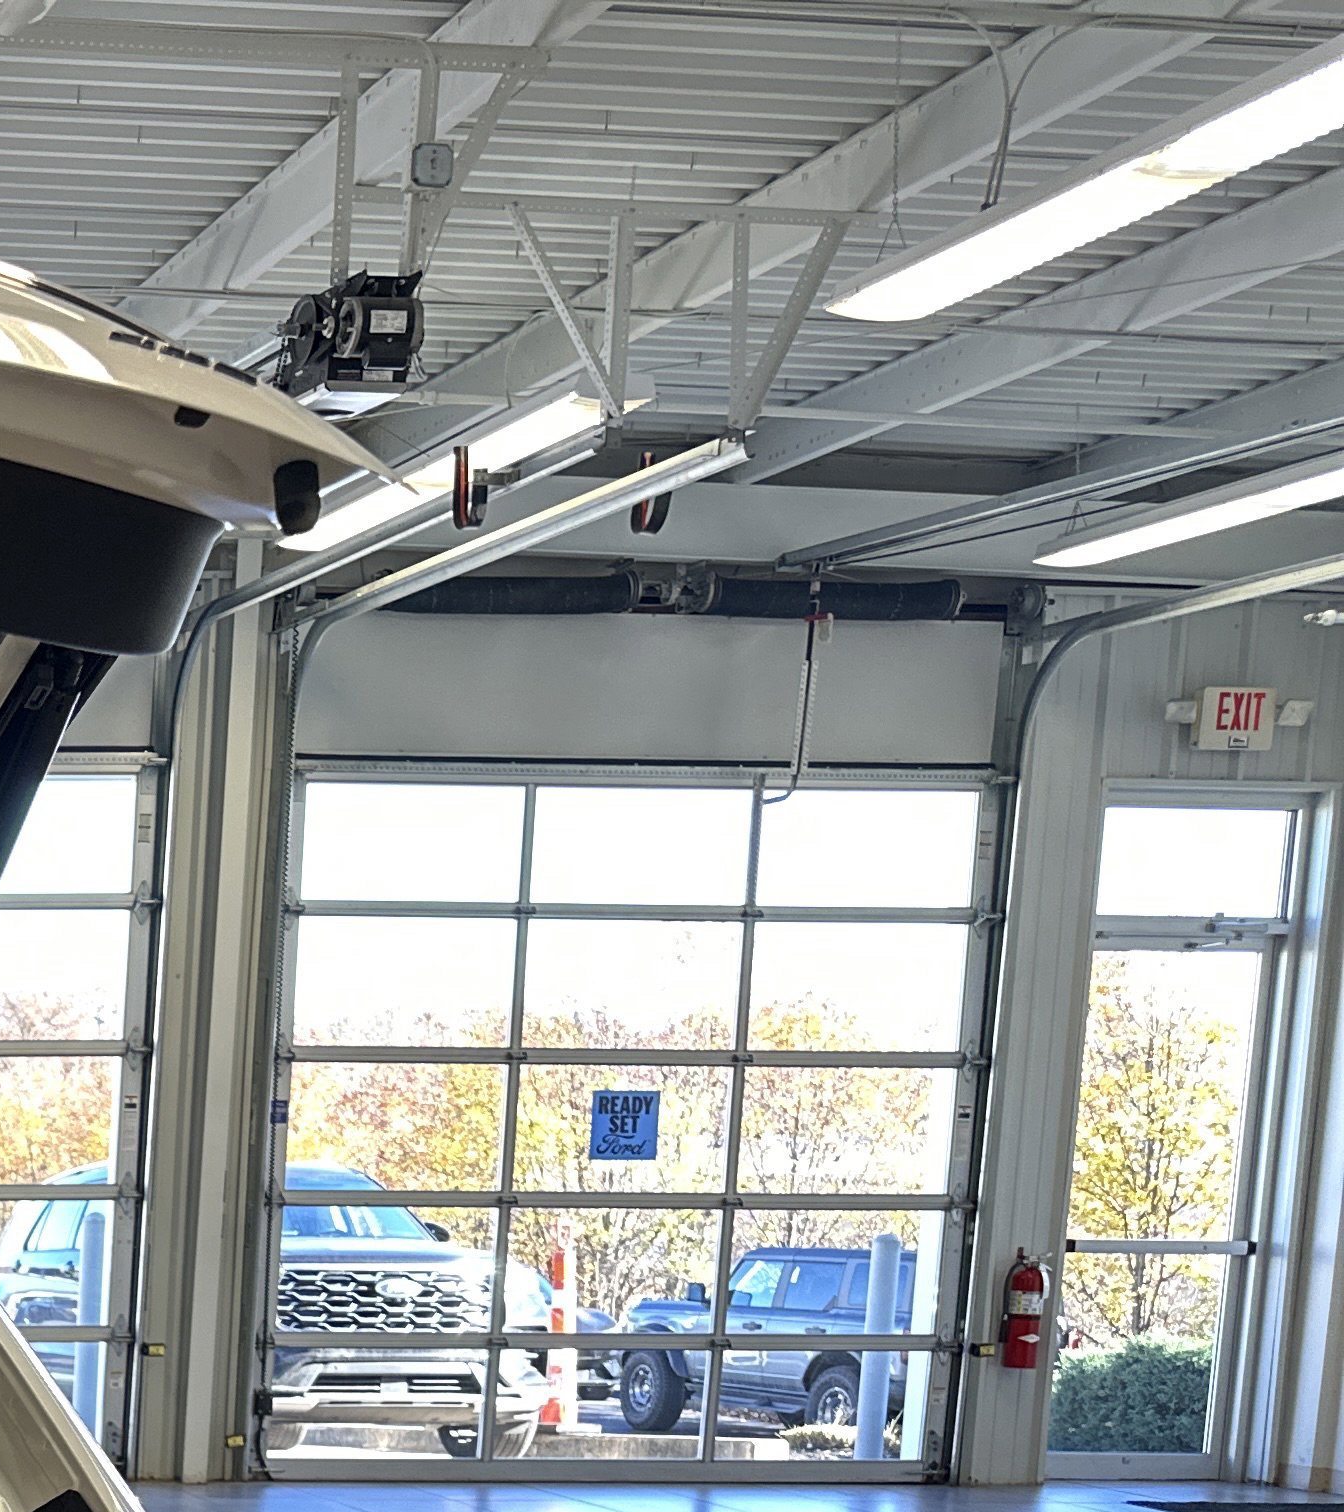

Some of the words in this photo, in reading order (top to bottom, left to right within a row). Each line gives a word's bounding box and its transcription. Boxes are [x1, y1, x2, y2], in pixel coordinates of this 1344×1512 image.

[1216, 692, 1266, 731] EXIT
[598, 1096, 653, 1115] READY
[608, 1115, 640, 1134] SET
[596, 1134, 648, 1155] Ford
